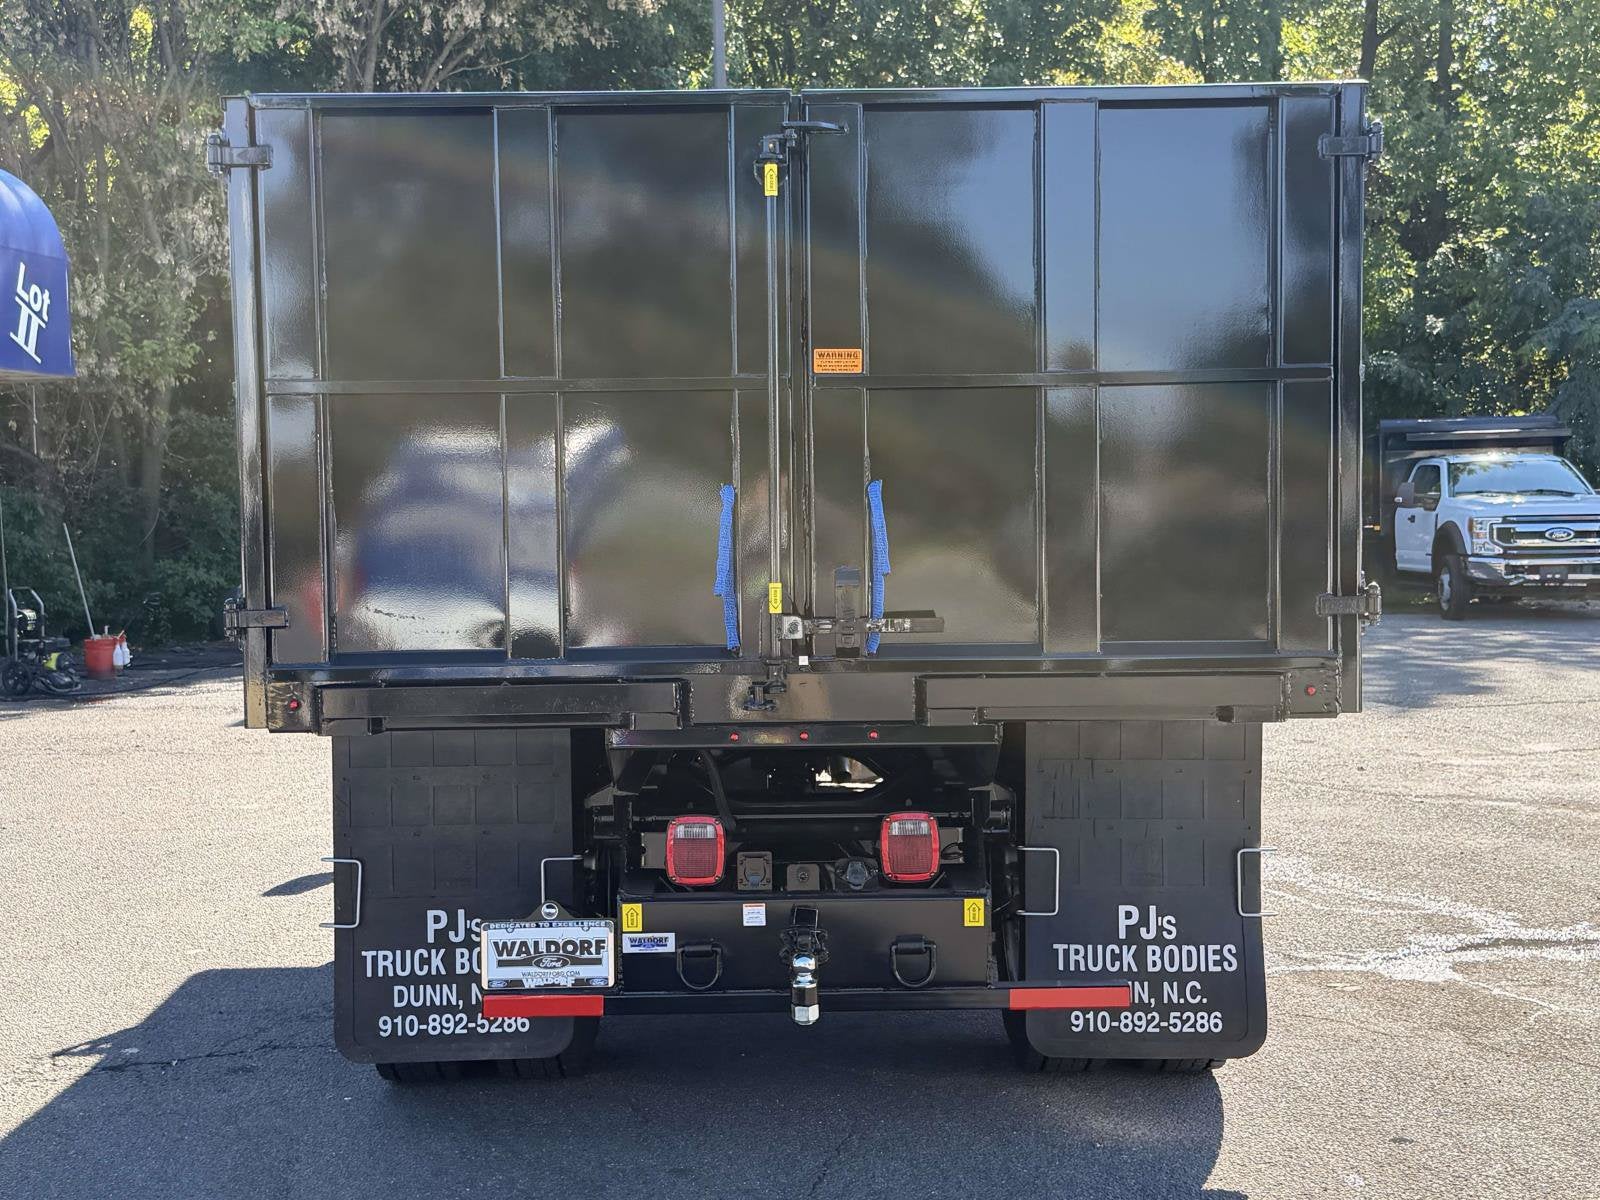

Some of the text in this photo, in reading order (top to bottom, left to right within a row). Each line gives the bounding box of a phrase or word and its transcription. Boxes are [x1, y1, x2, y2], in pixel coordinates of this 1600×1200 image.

[17, 262, 50, 322] Lot
[1118, 904, 1177, 940] PJ's
[492, 938, 607, 958] WALDORF
[627, 936, 669, 944] WALDORF
[361, 948, 447, 978] TRUCK
[539, 957, 563, 968] Ford
[1053, 944, 1238, 972] TRUCK BODIES
[522, 977, 575, 988] WALDORF
[1163, 981, 1208, 1004] N.C.
[393, 984, 464, 1010] DUNN,
[378, 1012, 531, 1037] 910-892-5286
[1070, 1011, 1223, 1033] 910-892-5286
